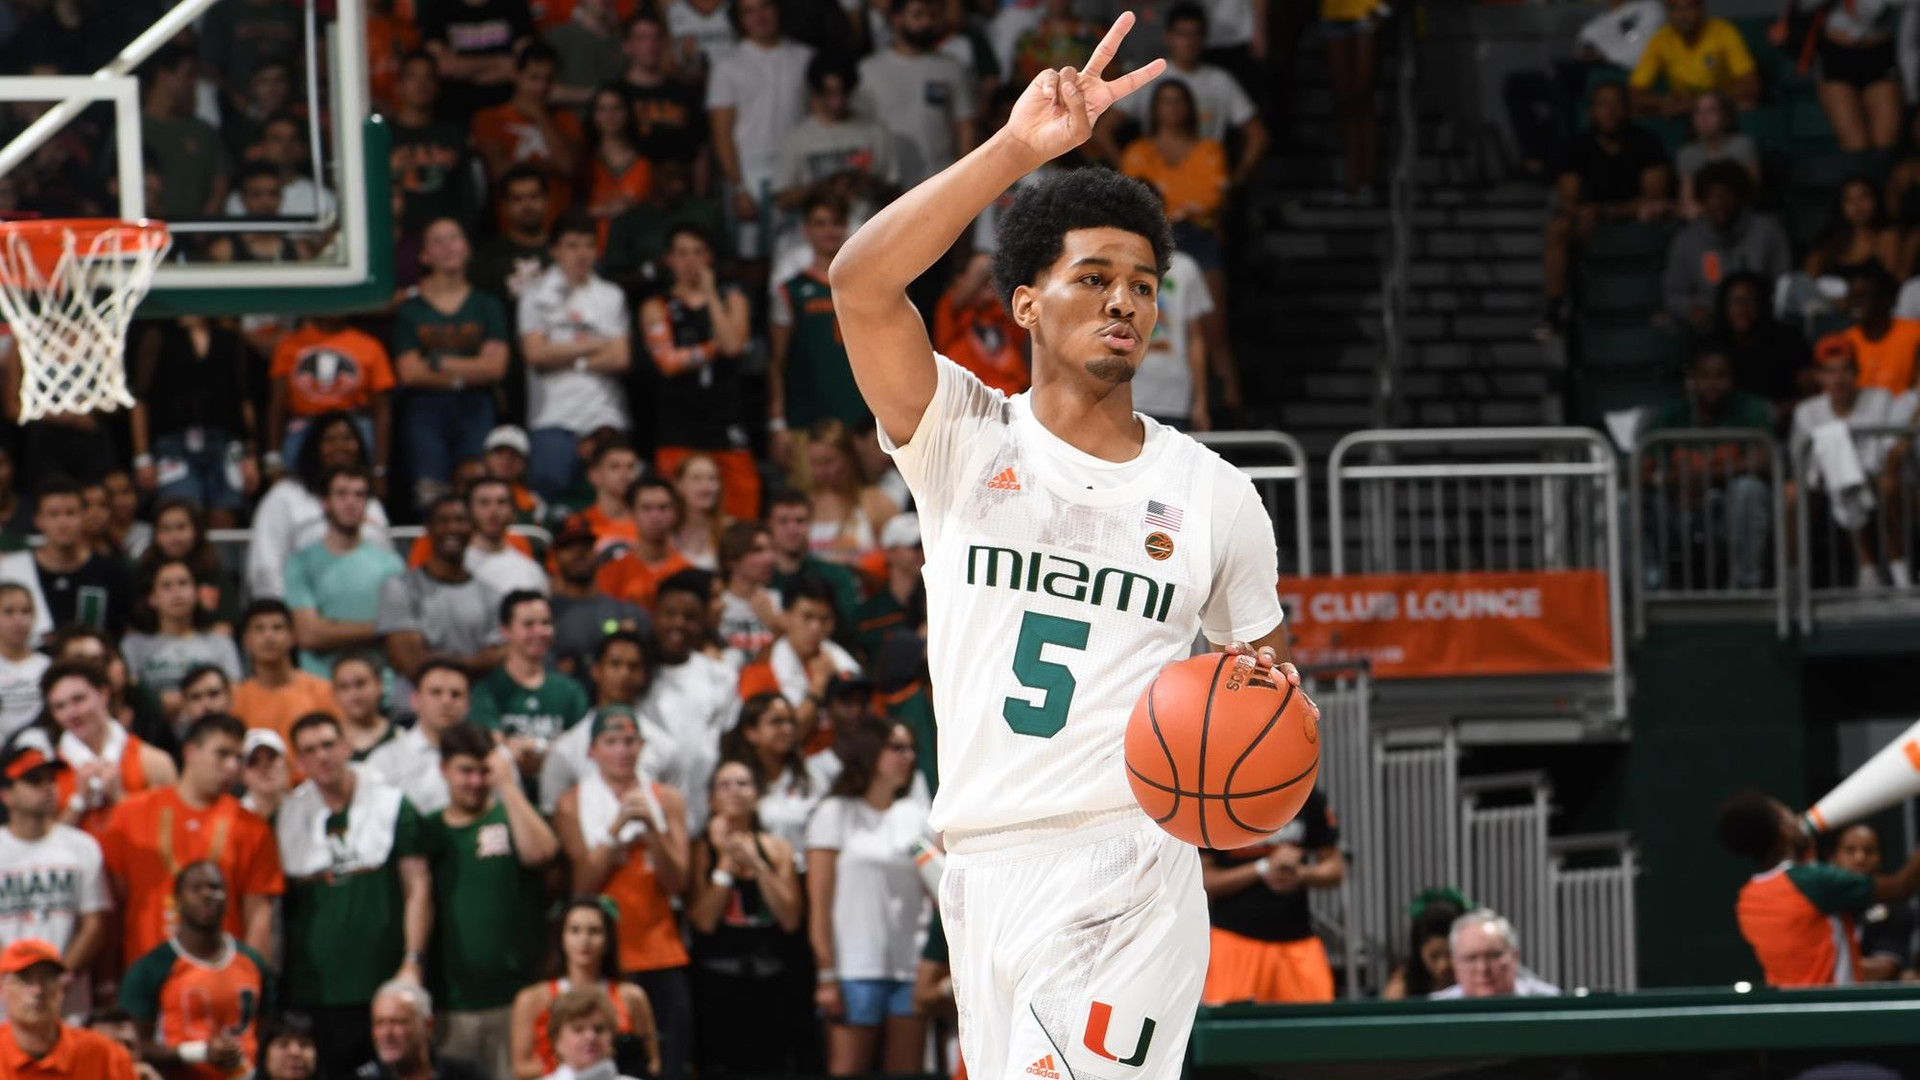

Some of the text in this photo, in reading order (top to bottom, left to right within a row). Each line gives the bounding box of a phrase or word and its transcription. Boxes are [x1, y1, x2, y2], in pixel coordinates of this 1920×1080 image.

[987, 480, 1021, 491] adidas
[1310, 591, 1399, 623] CLUB
[1405, 588, 1542, 621] LOUNGE
[1003, 610, 1091, 739] 5
[1083, 1000, 1157, 1067] U
[1026, 1066, 1060, 1080] adidas
